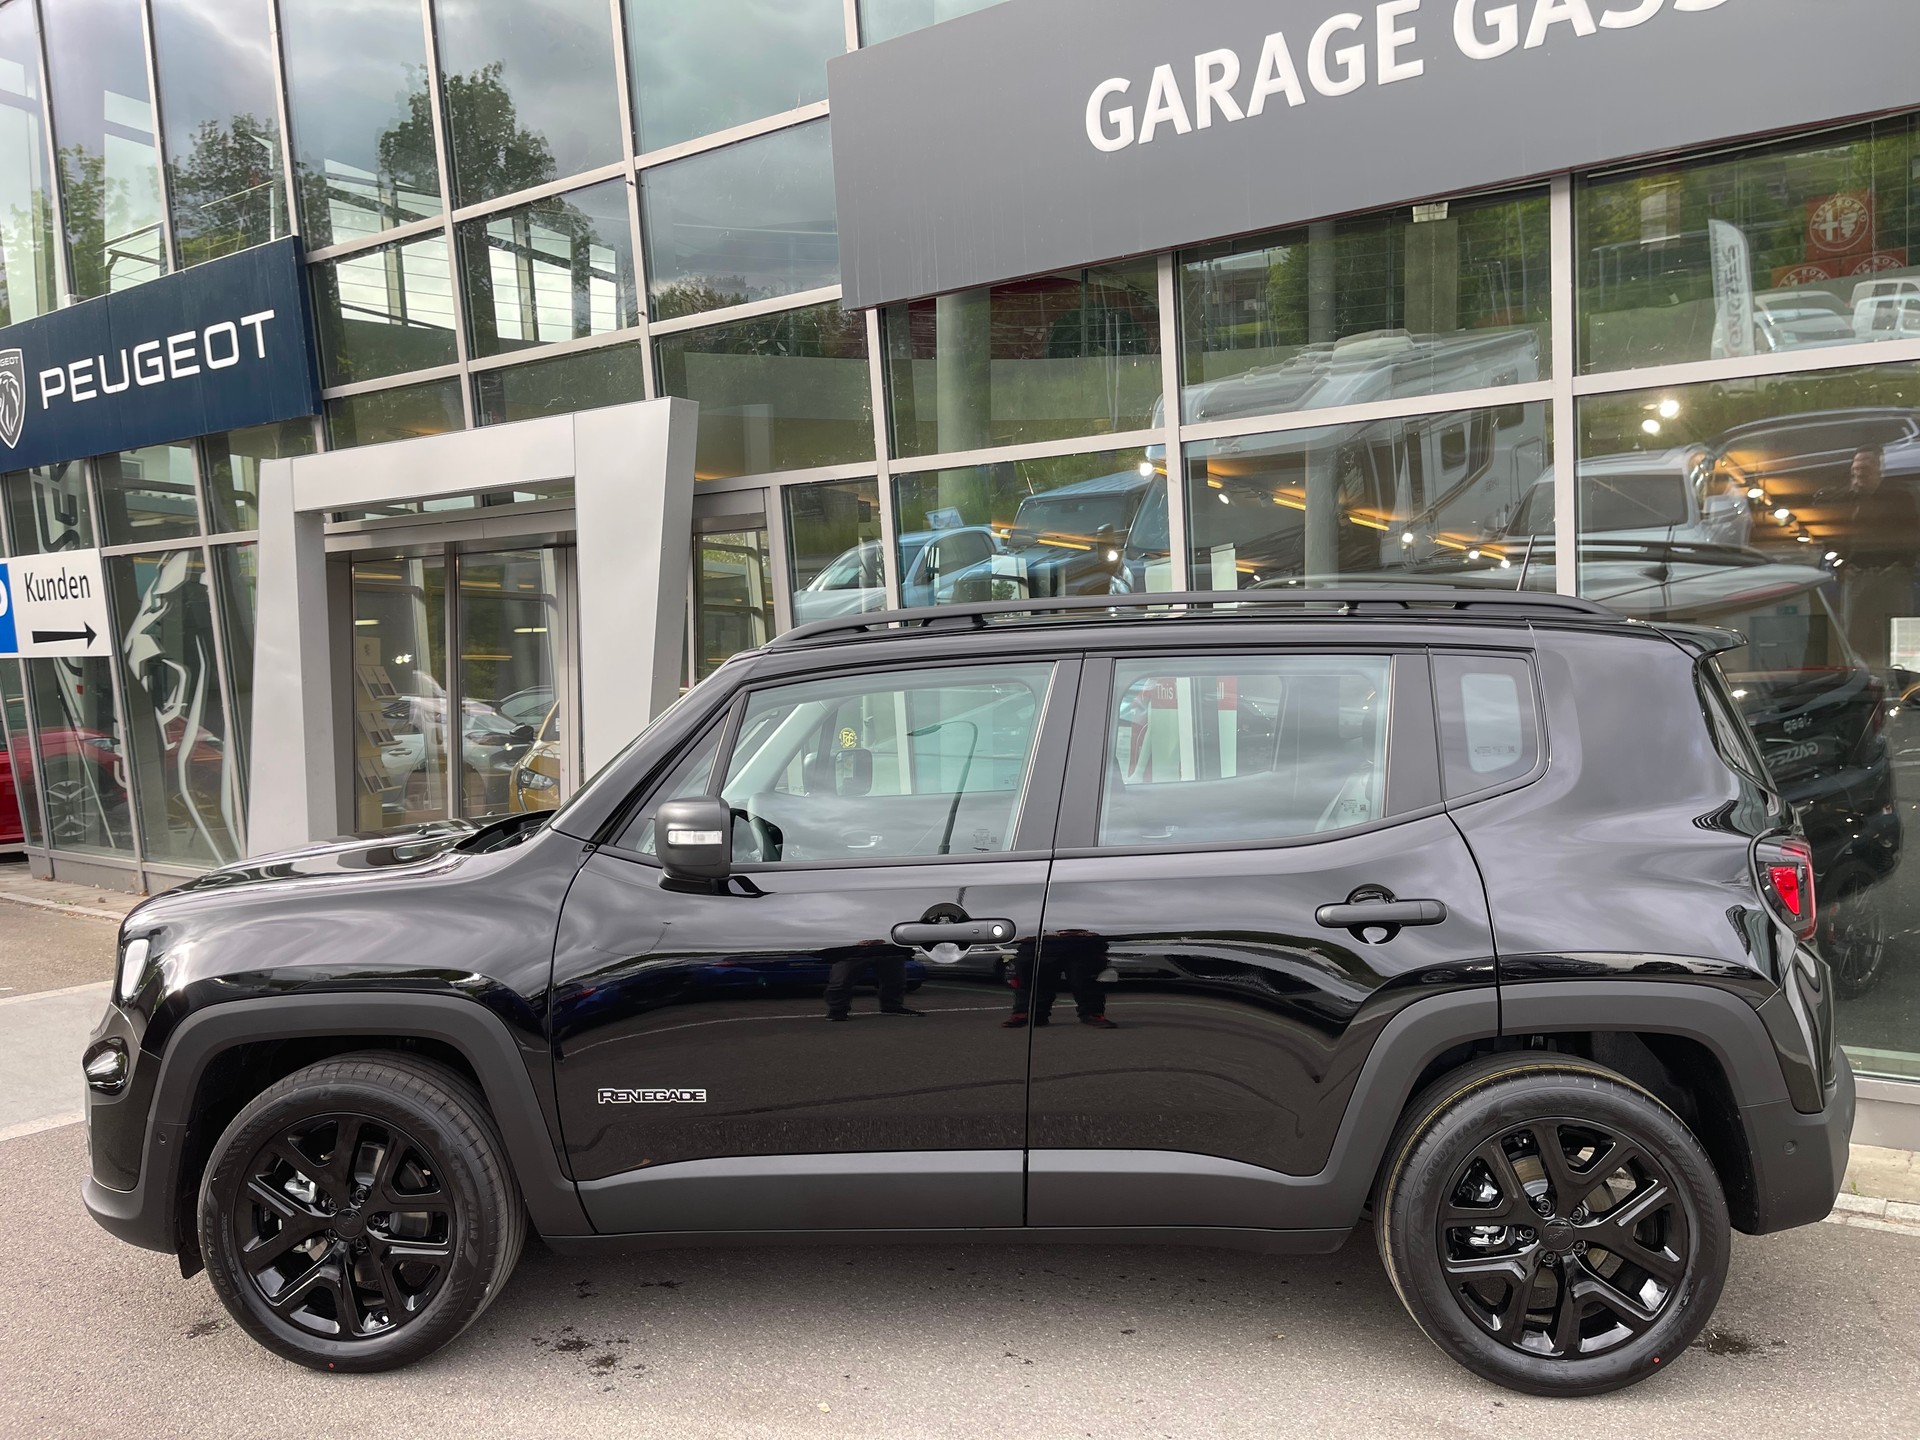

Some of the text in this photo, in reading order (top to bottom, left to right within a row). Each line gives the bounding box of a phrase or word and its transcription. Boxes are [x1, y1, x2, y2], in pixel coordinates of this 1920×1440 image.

[1085, 0, 1424, 152] GARAGE
[39, 309, 275, 410] PEUGEOT
[24, 566, 91, 603] Kunden
[1155, 682, 1174, 700] This
[597, 1088, 707, 1104] RENEGADE
